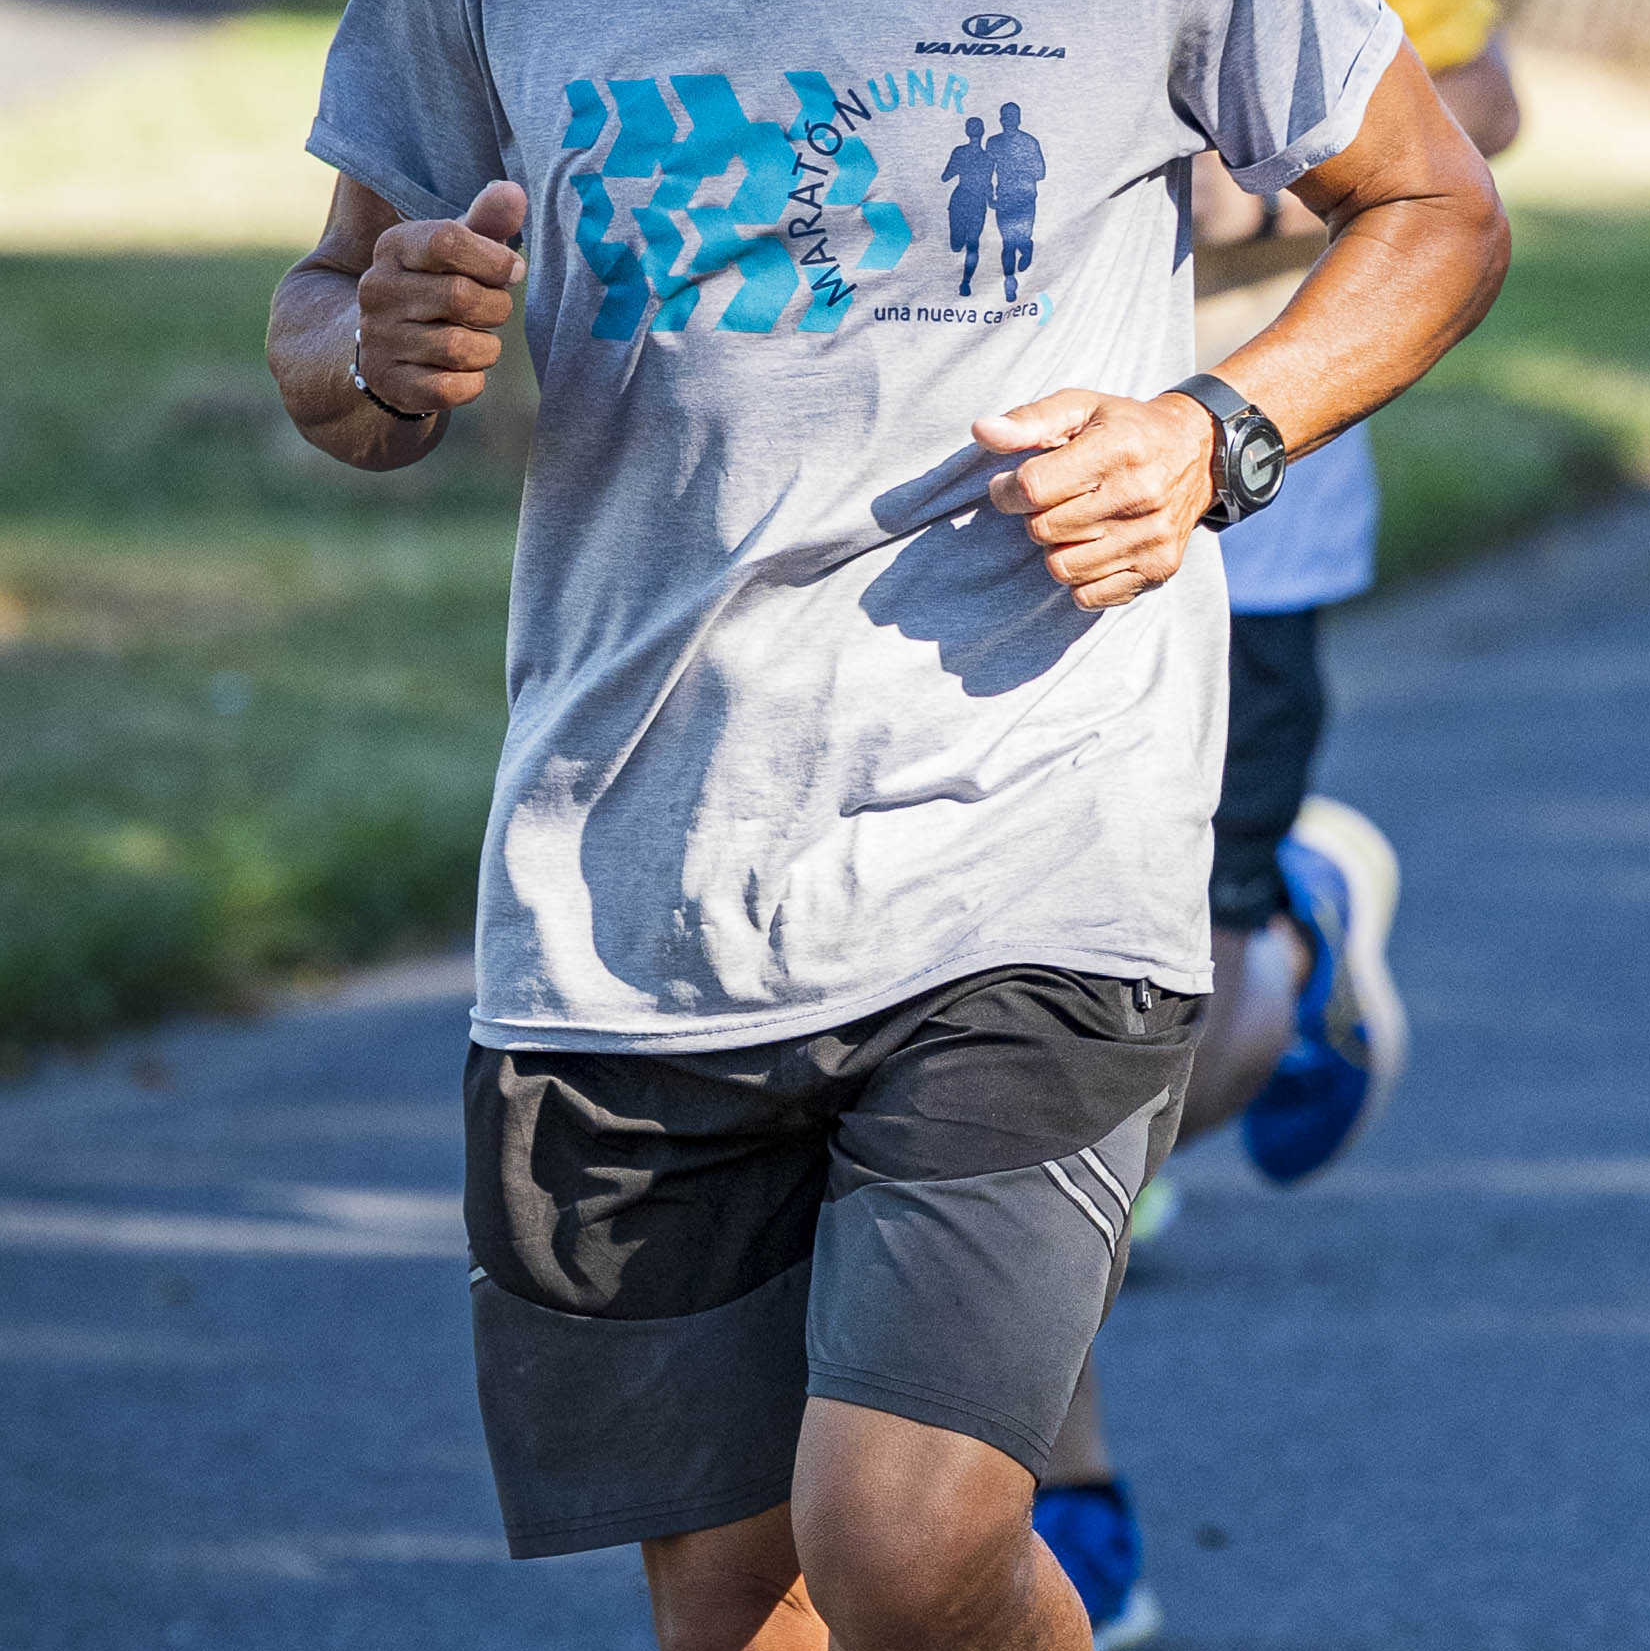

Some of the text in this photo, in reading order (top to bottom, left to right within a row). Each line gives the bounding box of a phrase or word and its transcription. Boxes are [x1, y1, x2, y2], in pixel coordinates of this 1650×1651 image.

[915, 41, 1066, 59] VANDALIA
[788, 69, 969, 307] MARATÓN UNR
[874, 306, 911, 322] una
[917, 308, 977, 323] nueva
